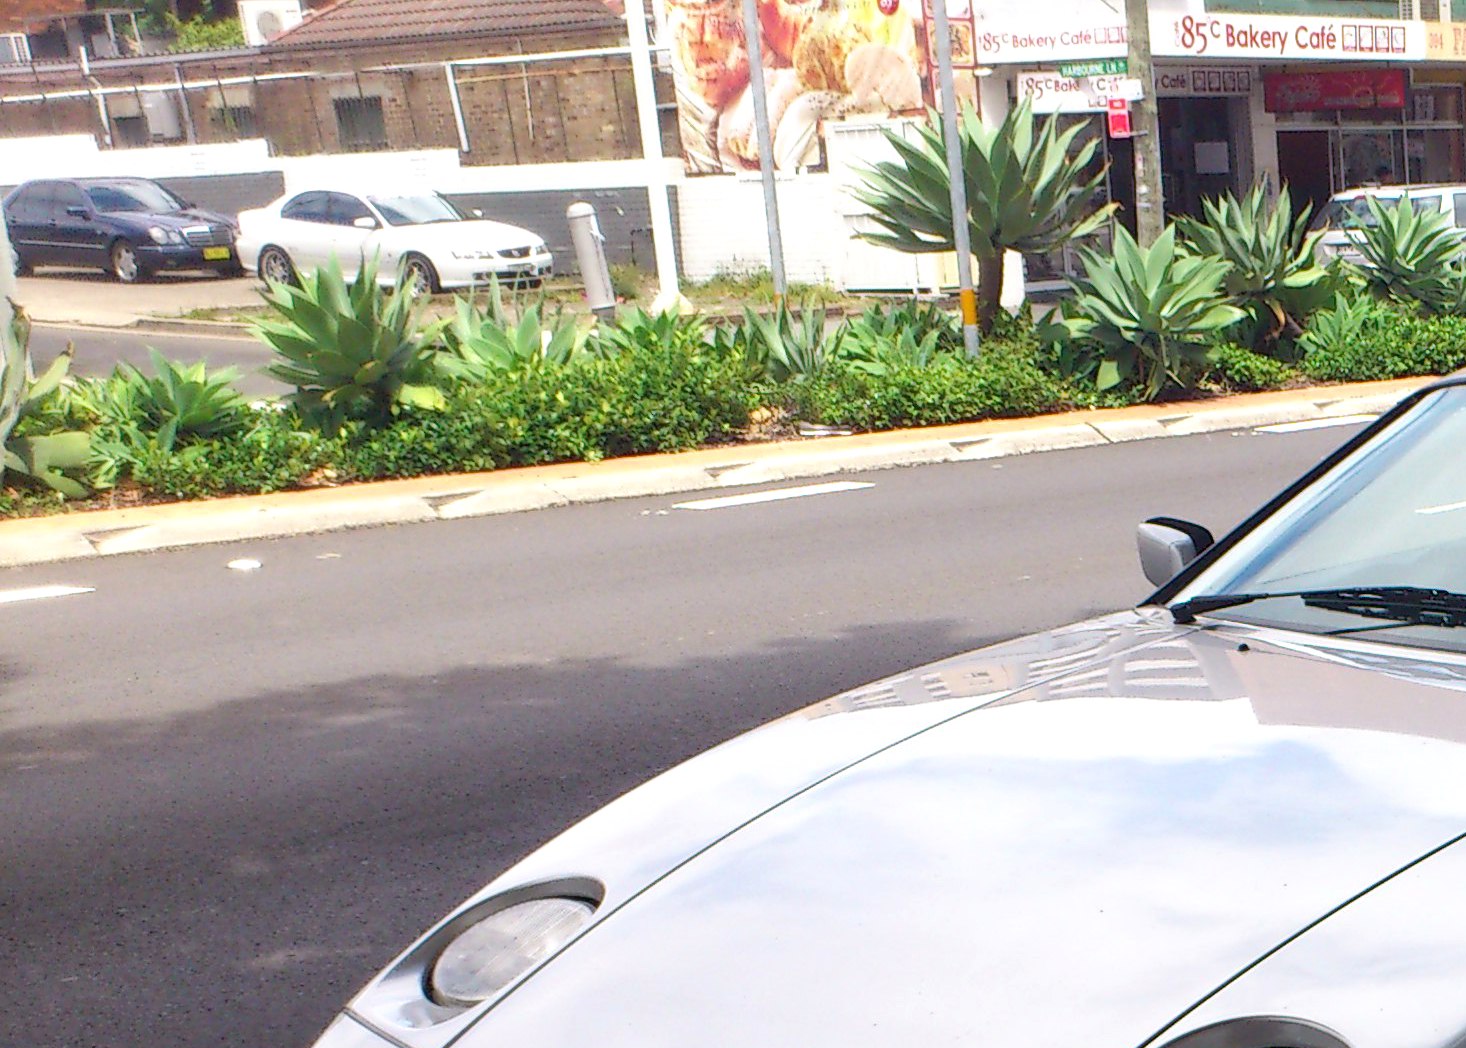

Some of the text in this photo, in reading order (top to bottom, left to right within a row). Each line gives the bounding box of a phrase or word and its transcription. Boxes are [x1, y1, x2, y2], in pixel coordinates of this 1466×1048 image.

[1012, 34, 1056, 51] Bakery
[1060, 29, 1092, 45] Café
[1226, 23, 1288, 55] Bakery
[1295, 24, 1337, 50] Café
[1161, 74, 1186, 89] Café
